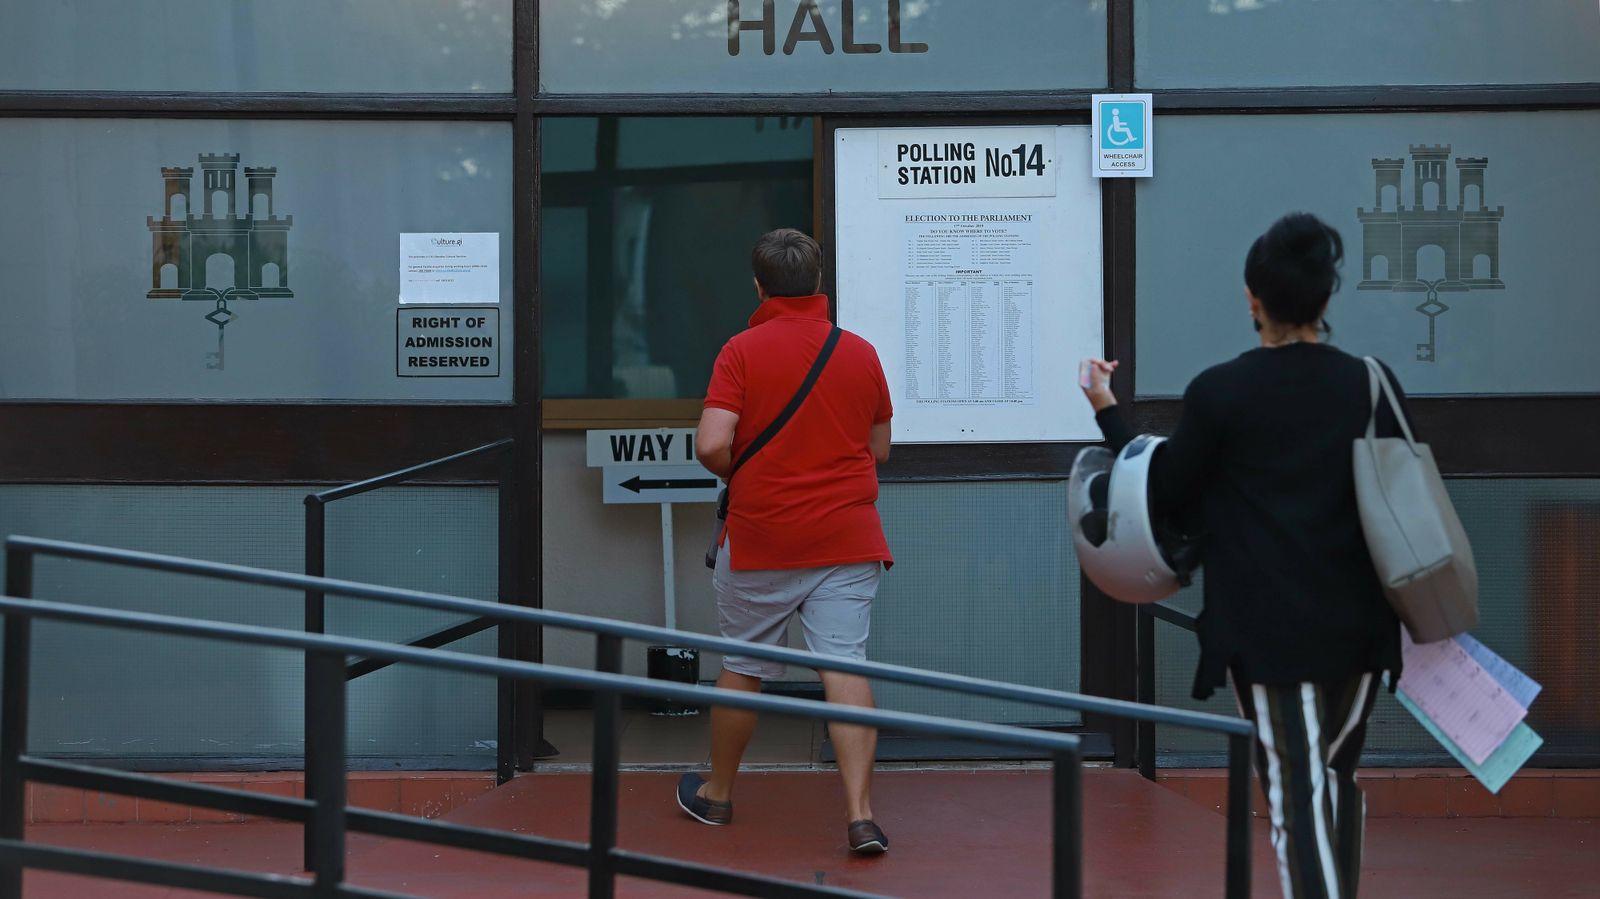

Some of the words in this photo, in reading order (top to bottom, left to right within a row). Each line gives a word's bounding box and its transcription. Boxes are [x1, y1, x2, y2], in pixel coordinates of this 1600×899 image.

[727, 0, 929, 55] HALL
[897, 143, 975, 162] POLLING
[897, 165, 976, 185] STATION
[412, 317, 460, 328] RIGHT
[466, 317, 486, 328] OF
[405, 336, 492, 348] ADMISSION
[408, 356, 490, 367] RESERVED
[610, 434, 674, 462] WAY
